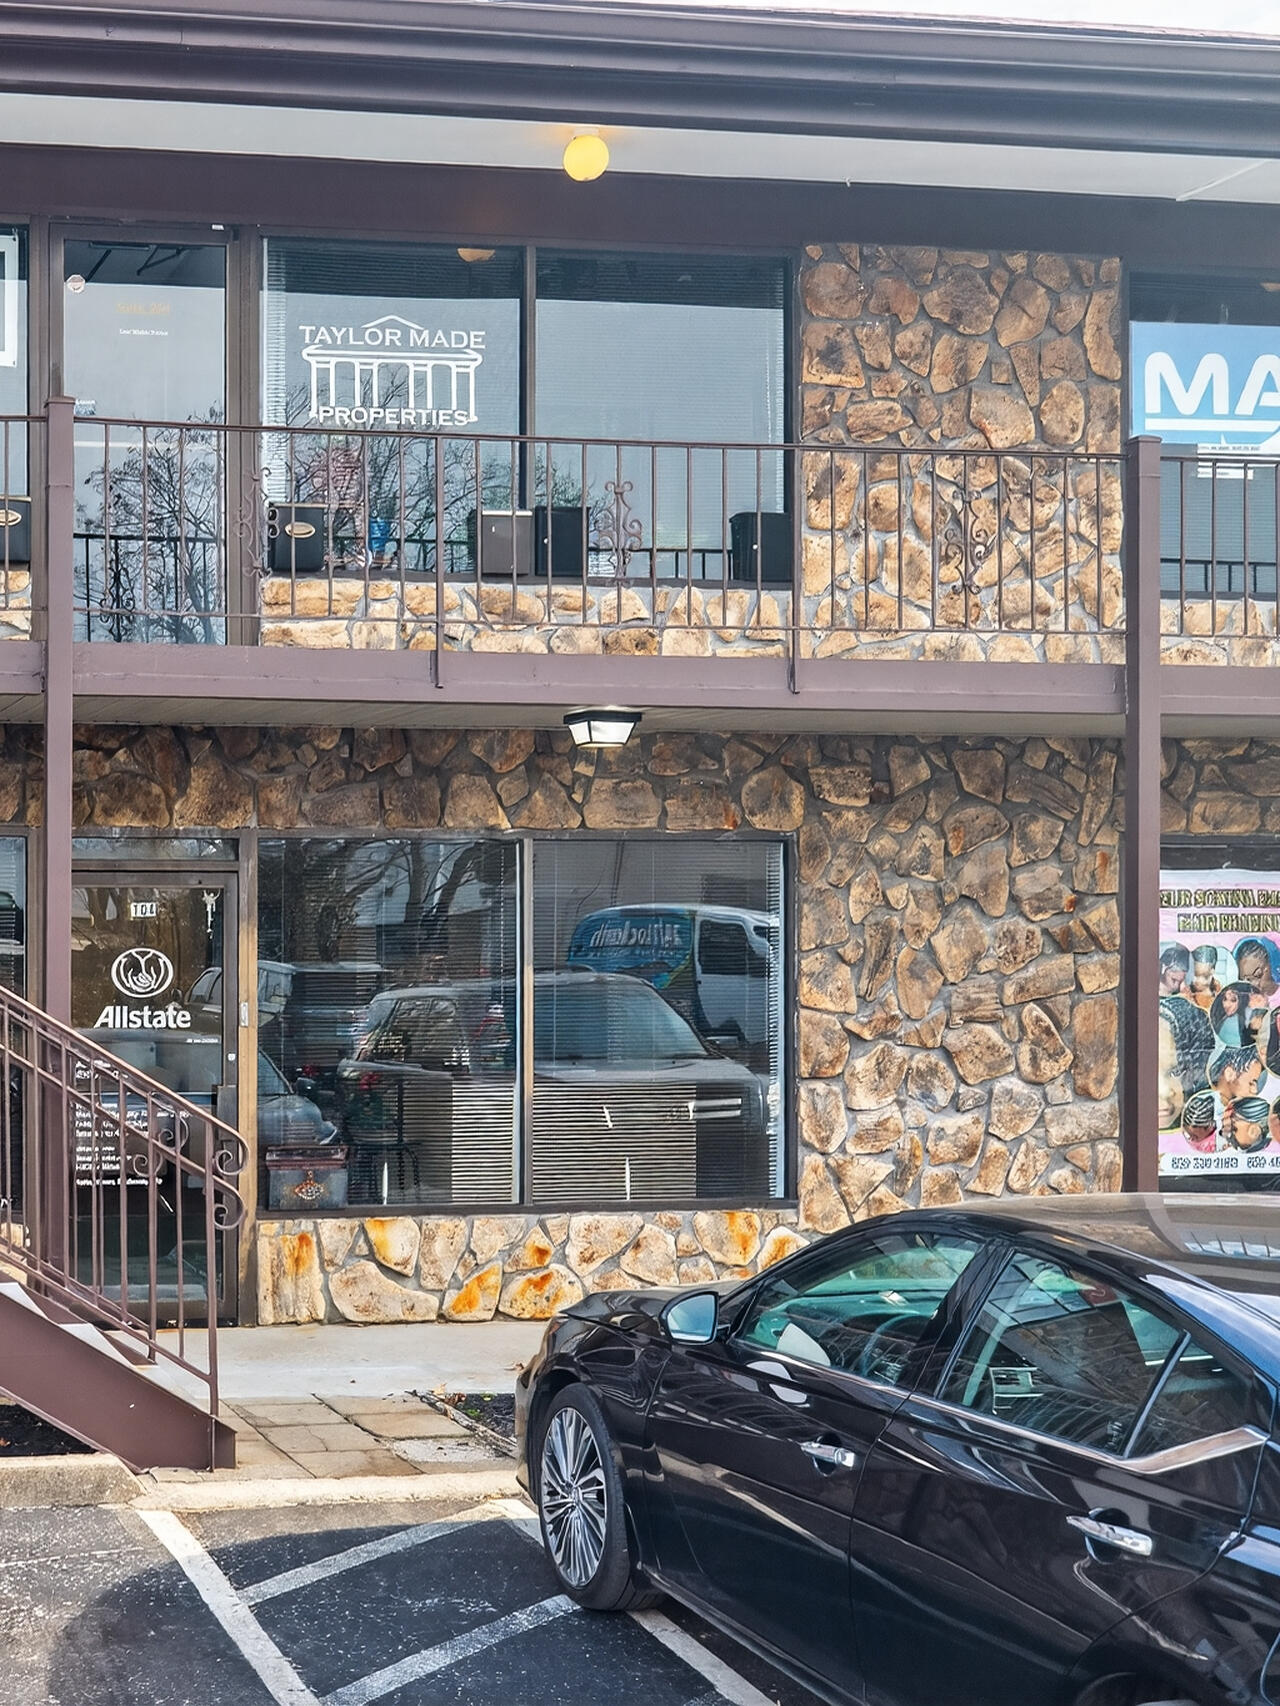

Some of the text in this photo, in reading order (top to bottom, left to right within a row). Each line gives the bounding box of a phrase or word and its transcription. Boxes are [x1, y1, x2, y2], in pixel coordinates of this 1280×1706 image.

[299, 325, 486, 349] TAYLOR MADE
[319, 405, 469, 426] PROPERTIES
[93, 1005, 191, 1029] Allstate
